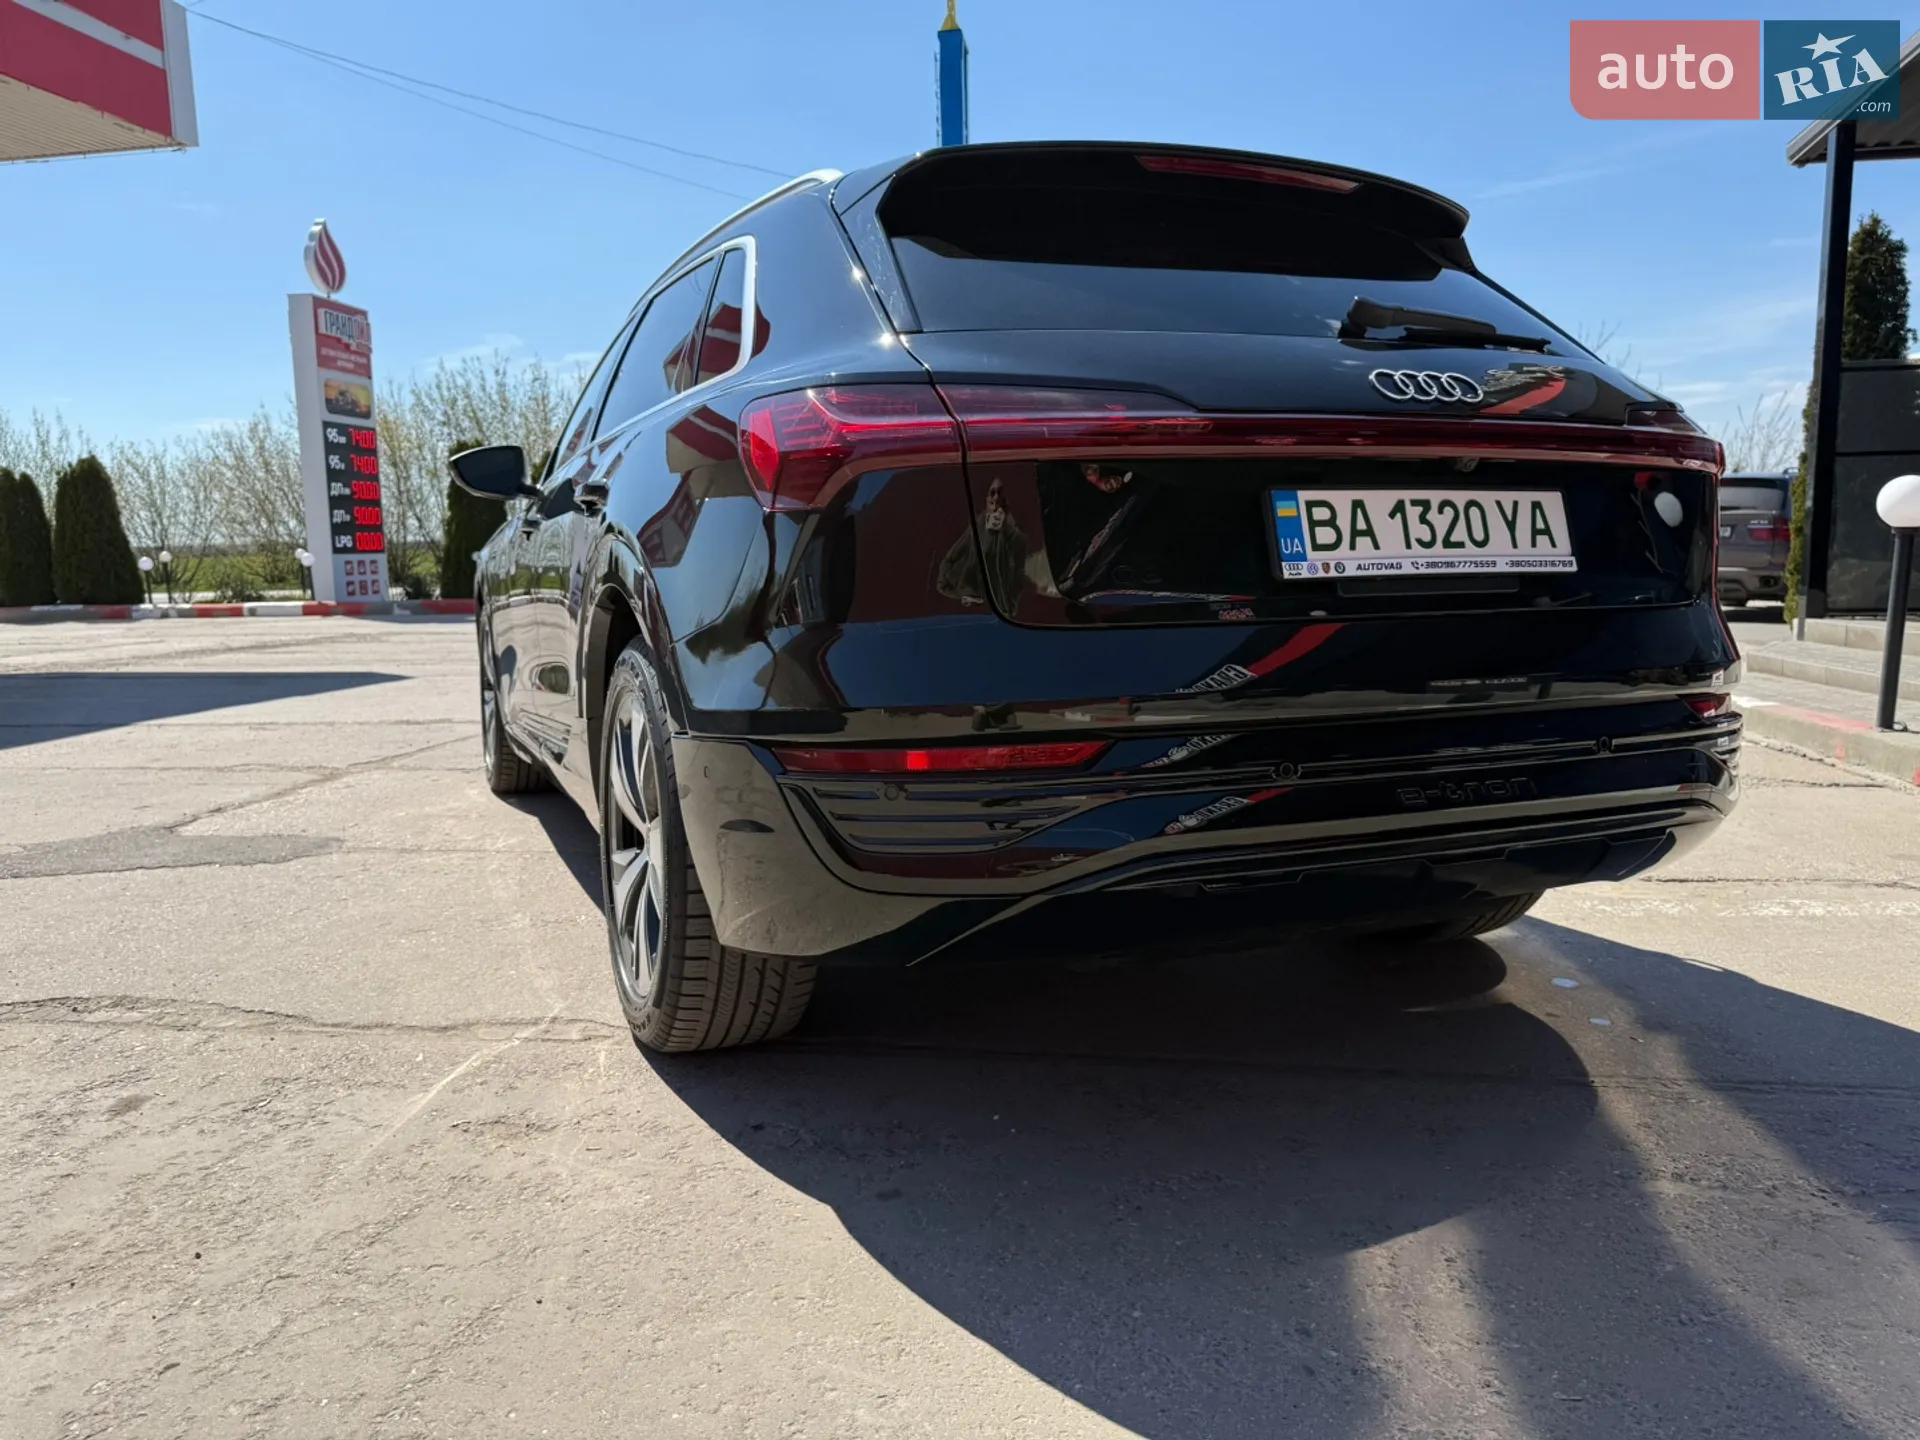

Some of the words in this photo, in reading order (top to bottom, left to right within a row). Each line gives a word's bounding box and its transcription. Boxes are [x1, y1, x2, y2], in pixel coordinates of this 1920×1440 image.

[1305, 498, 1380, 552] BA
[1388, 498, 1490, 550] 1320
[1496, 499, 1557, 549] YA
[335, 535, 352, 548] LPG
[1281, 537, 1303, 555] UA
[1398, 776, 1537, 805] e-tron
